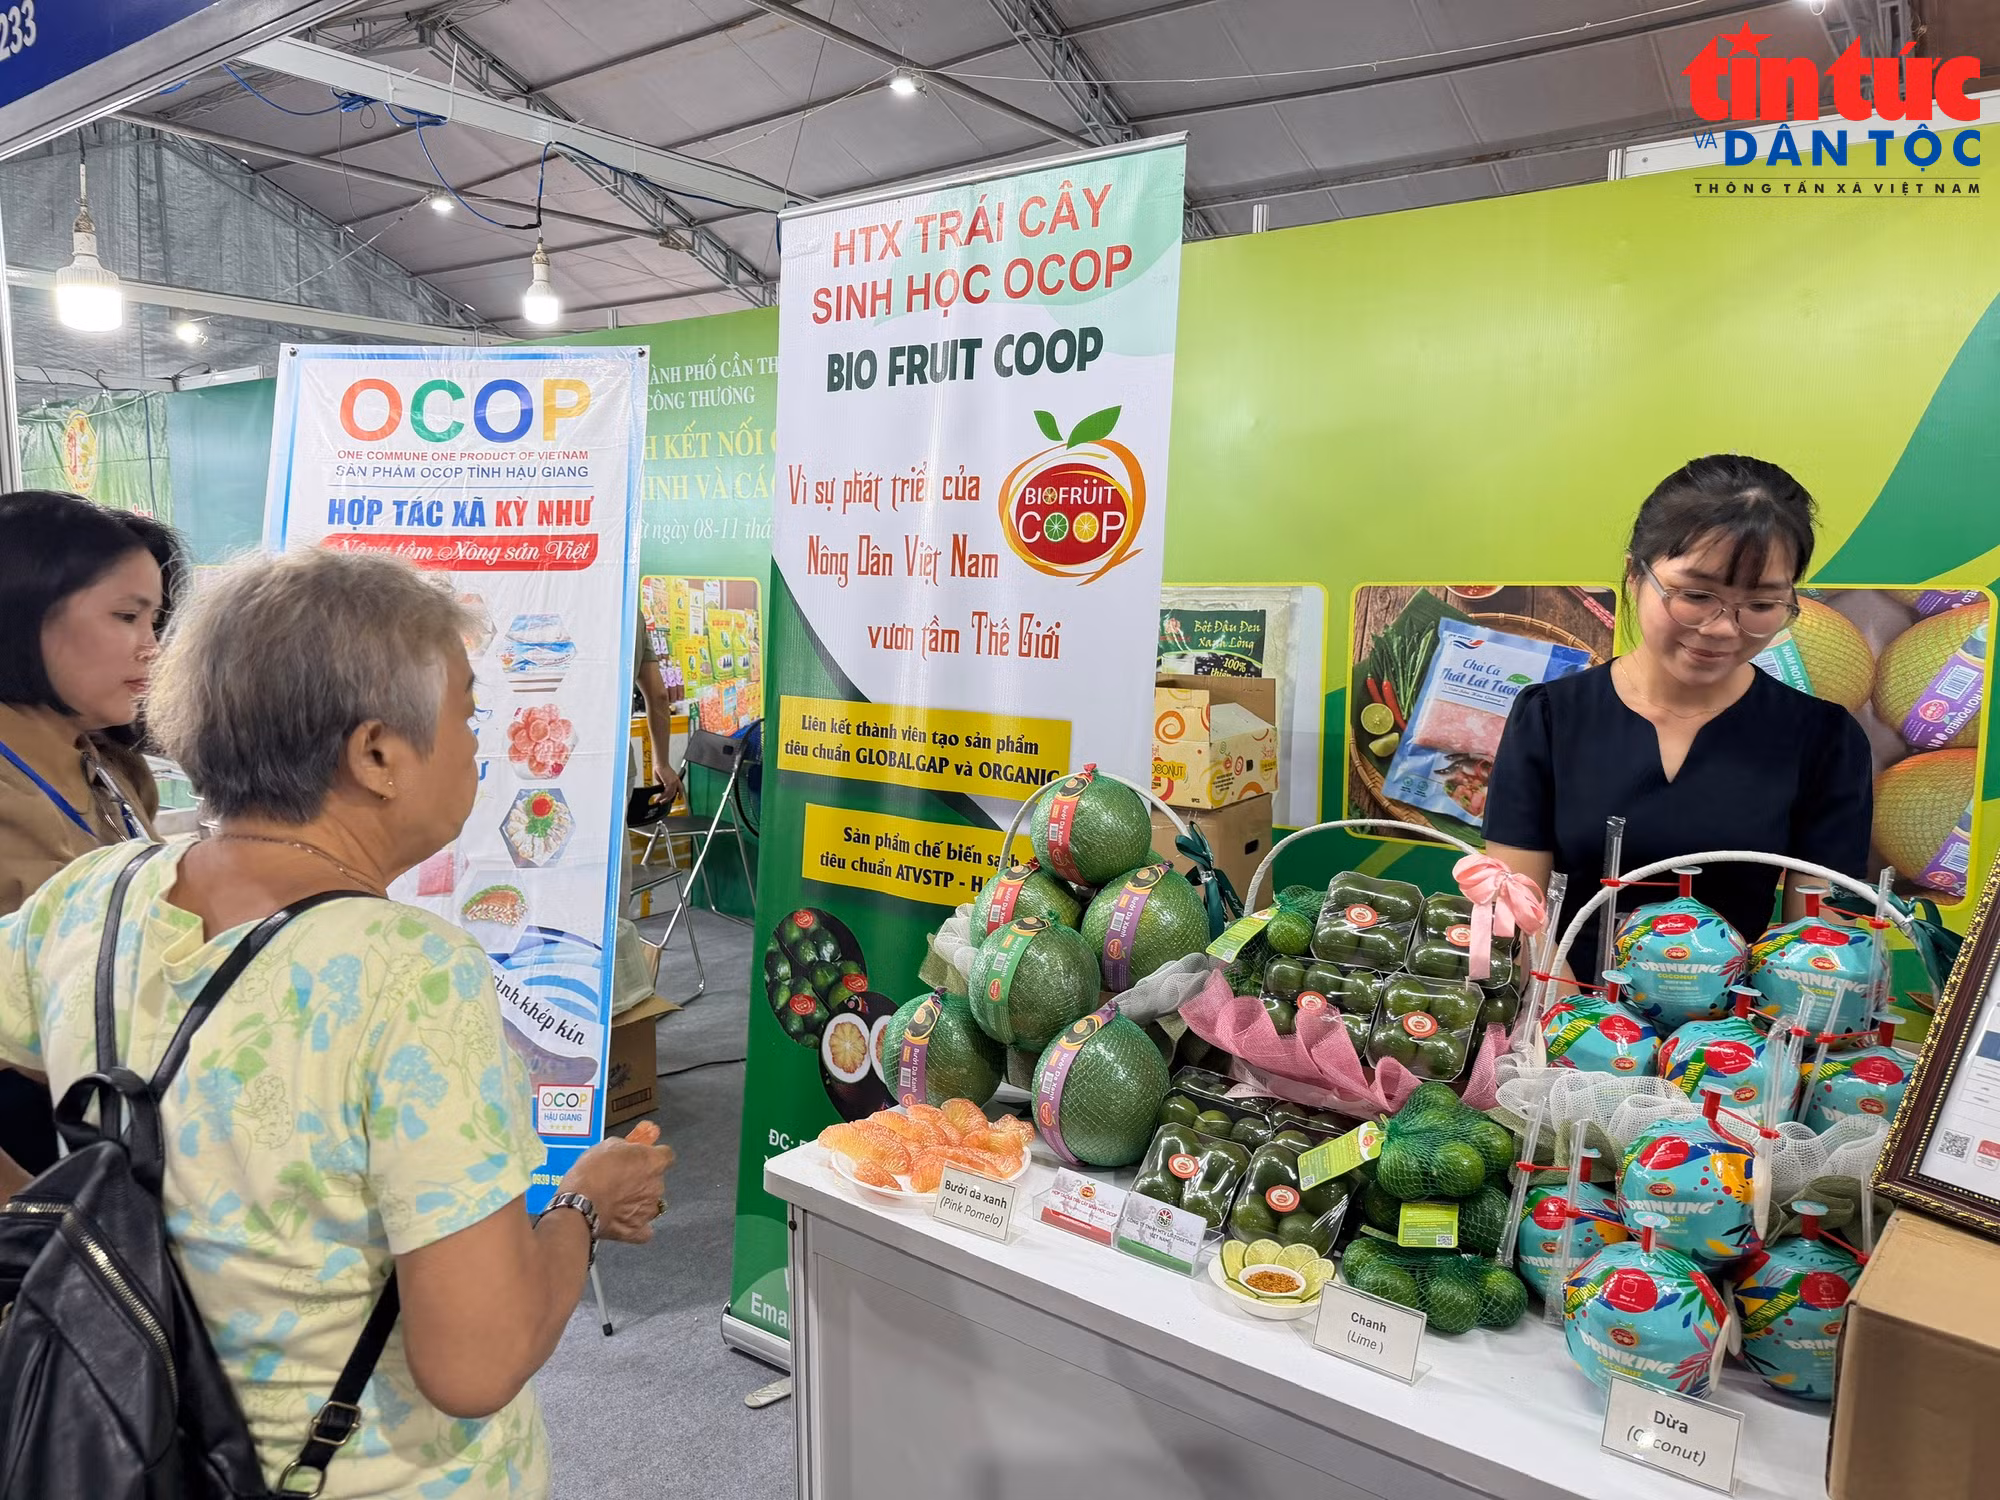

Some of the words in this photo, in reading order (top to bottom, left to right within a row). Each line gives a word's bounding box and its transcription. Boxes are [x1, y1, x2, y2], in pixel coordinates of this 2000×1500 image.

[0, 0, 36, 61] 233
[833, 220, 903, 268] HTX
[915, 194, 1005, 254] TRÁI
[1018, 179, 1112, 238] CÂY
[812, 278, 893, 324] SINH
[907, 264, 991, 318] HỌC
[1003, 244, 1133, 300] OCOP
[648, 364, 682, 385] ÀNH
[685, 354, 716, 382] PHỐ
[720, 351, 753, 378] CẦN
[827, 348, 878, 392] BIO
[888, 337, 983, 387] FRUIT
[994, 326, 1104, 379] COOP
[339, 378, 592, 443] OCOP
[689, 386, 755, 408] THƯƠNG
[664, 420, 711, 460] KẾT
[718, 416, 764, 457] NỐI
[337, 450, 364, 461] ONE
[366, 450, 429, 462] COMMUNE
[431, 451, 456, 462] ONE
[459, 451, 516, 462] PRODUCT
[519, 451, 536, 461] OF
[538, 450, 589, 461] VIETNAM
[421, 467, 463, 479] OCOP
[541, 465, 589, 479] GIANG
[695, 466, 729, 500] VÀ
[735, 464, 775, 499] CÁ
[788, 464, 808, 505] Vì
[815, 477, 837, 512] sự
[842, 467, 883, 515] phát
[891, 461, 929, 513] triể
[942, 464, 981, 501] của
[327, 495, 383, 530] HỢP
[393, 495, 443, 527] TÁC
[452, 496, 487, 528] XÃ
[495, 496, 528, 528] KỲ
[538, 495, 595, 527] NHƯ
[1018, 511, 1125, 544] COOP
[652, 519, 690, 545] ngày
[694, 517, 738, 539] 08-11
[745, 517, 773, 539] thá
[438, 540, 502, 565] Nông
[504, 543, 540, 561] sản
[544, 540, 590, 563] Việt
[807, 534, 849, 588] Nông
[857, 534, 894, 577] Dân
[904, 534, 942, 587] Việt
[950, 533, 998, 578] Nam
[867, 622, 914, 651] vươn
[921, 615, 960, 662] tầm
[971, 611, 1010, 656] Thế
[1018, 612, 1062, 660] Giới
[1194, 619, 1212, 633] Bột
[1239, 620, 1261, 633] Đen
[1223, 657, 1247, 672] 100%
[1781, 645, 1795, 665] NAM
[1790, 663, 1803, 680] ROI
[801, 714, 827, 733] Liên
[830, 717, 852, 735] kết
[856, 720, 897, 740] thành
[901, 725, 927, 743] viên
[932, 730, 960, 749] tạo
[965, 730, 991, 749] sản
[996, 734, 1039, 756] phẩm
[1944, 706, 1973, 735] POMELO
[785, 740, 808, 757] tiêu
[812, 744, 851, 762] chuẩn
[954, 761, 973, 777] và
[844, 826, 871, 845] Sản
[875, 832, 910, 854] phẩm
[914, 840, 943, 859] chế
[946, 842, 983, 865] biến
[987, 852, 1020, 871] sạh
[820, 851, 846, 870] tiêu
[851, 856, 892, 878] chuẩn
[896, 864, 954, 888] ATVSTP
[1637, 961, 1723, 974] DRINKING
[494, 974, 519, 1005] rình
[519, 998, 555, 1032] khép
[555, 1019, 585, 1046] kín
[1680, 1062, 1706, 1093] NATURAL
[542, 1092, 588, 1108] OCOP
[559, 1113, 582, 1122] GIANG
[945, 1180, 969, 1197] Bưởi
[983, 1193, 1007, 1209] xanh
[1628, 1200, 1715, 1214] DRINKING
[940, 1196, 963, 1213] (Pink
[964, 1204, 1004, 1228] Pomelo)
[751, 1291, 791, 1331] Ema
[1761, 1291, 1799, 1318] NATURAL
[1347, 1329, 1377, 1350] (Lime
[1351, 1311, 1387, 1334] Chanh
[1580, 1329, 1675, 1374] DRINKING
[1653, 1410, 1689, 1434] Dừa
[1626, 1425, 1707, 1467] (Cconut)
